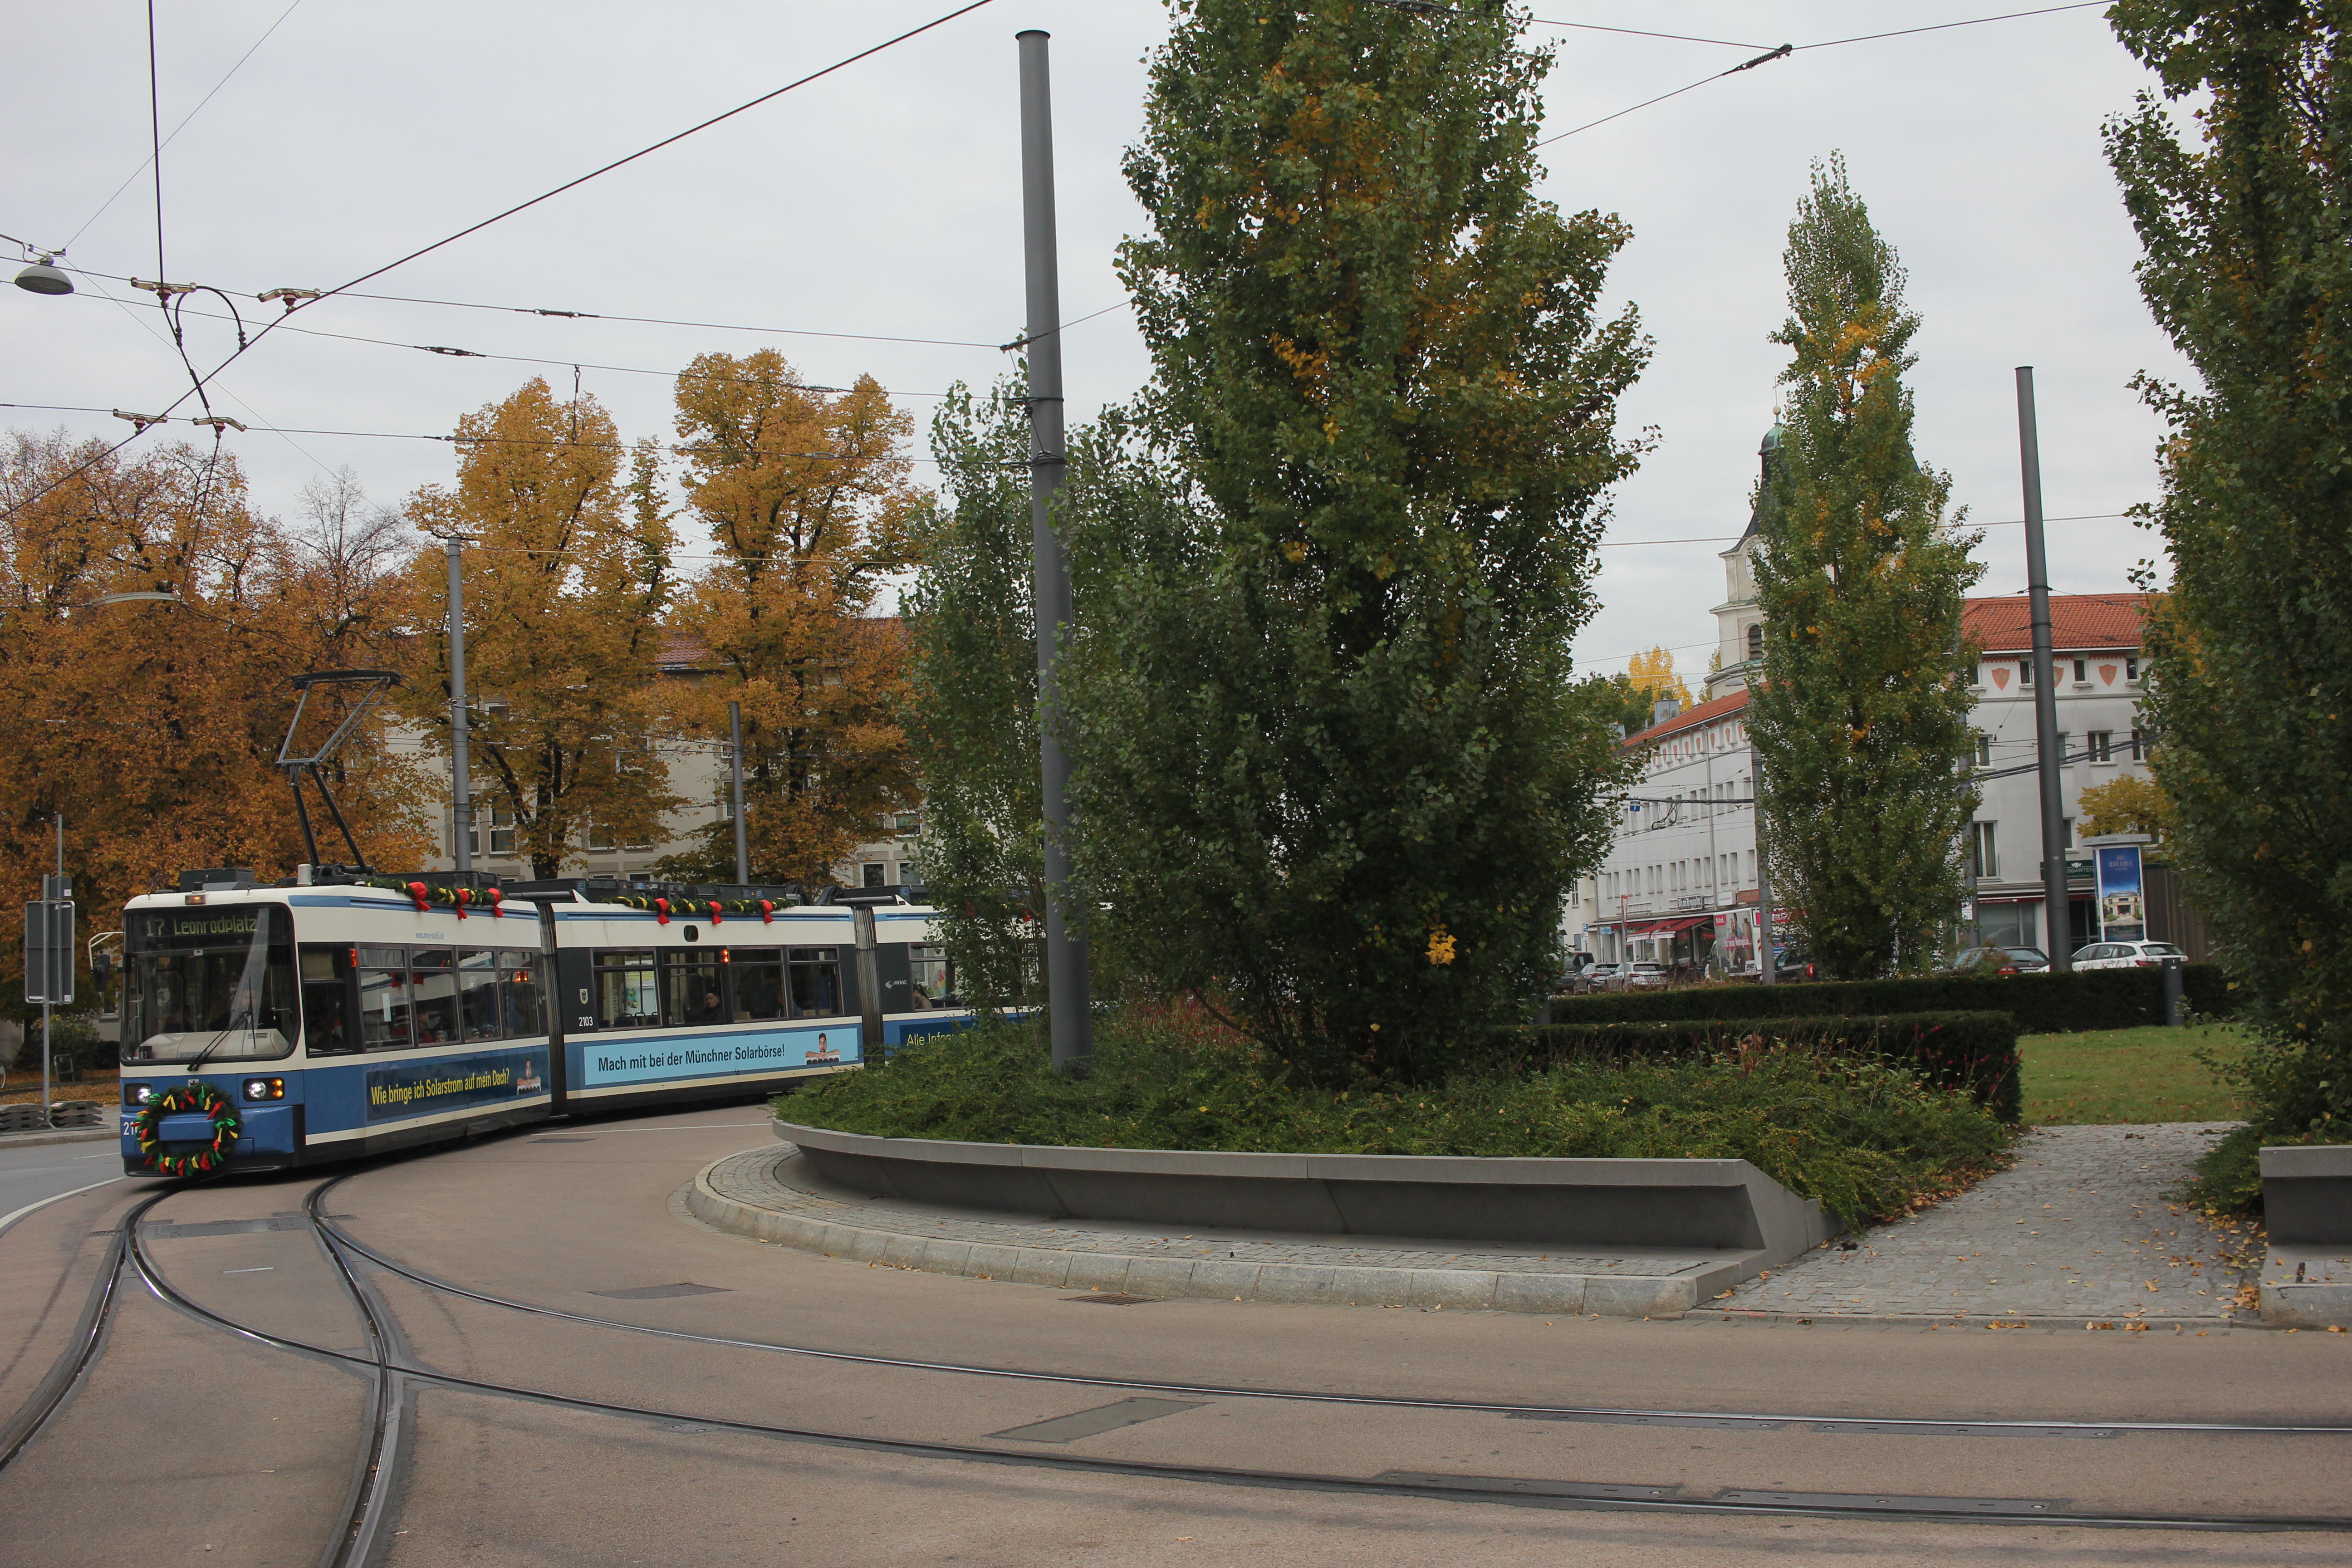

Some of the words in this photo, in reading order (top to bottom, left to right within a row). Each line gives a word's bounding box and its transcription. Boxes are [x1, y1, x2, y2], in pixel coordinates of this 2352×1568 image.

[146, 918, 165, 936] 17
[174, 914, 258, 936] Leonrodplatz
[578, 1016, 593, 1027] 2103
[906, 1034, 925, 1047] Alle
[598, 1056, 626, 1072] Mach
[630, 1054, 647, 1069] mit
[650, 1053, 664, 1067] bei
[667, 1052, 683, 1066] der
[685, 1046, 733, 1064] Münchner
[735, 1044, 785, 1060] Solarbörse!
[371, 1085, 387, 1105] Wie
[388, 1083, 412, 1105] bringe
[414, 1081, 425, 1099] ich
[426, 1078, 463, 1098] Solarstrom
[465, 1073, 475, 1090] auf
[476, 1071, 491, 1088] mein
[492, 1068, 510, 1086] Dach?
[123, 1121, 142, 1136] 21
